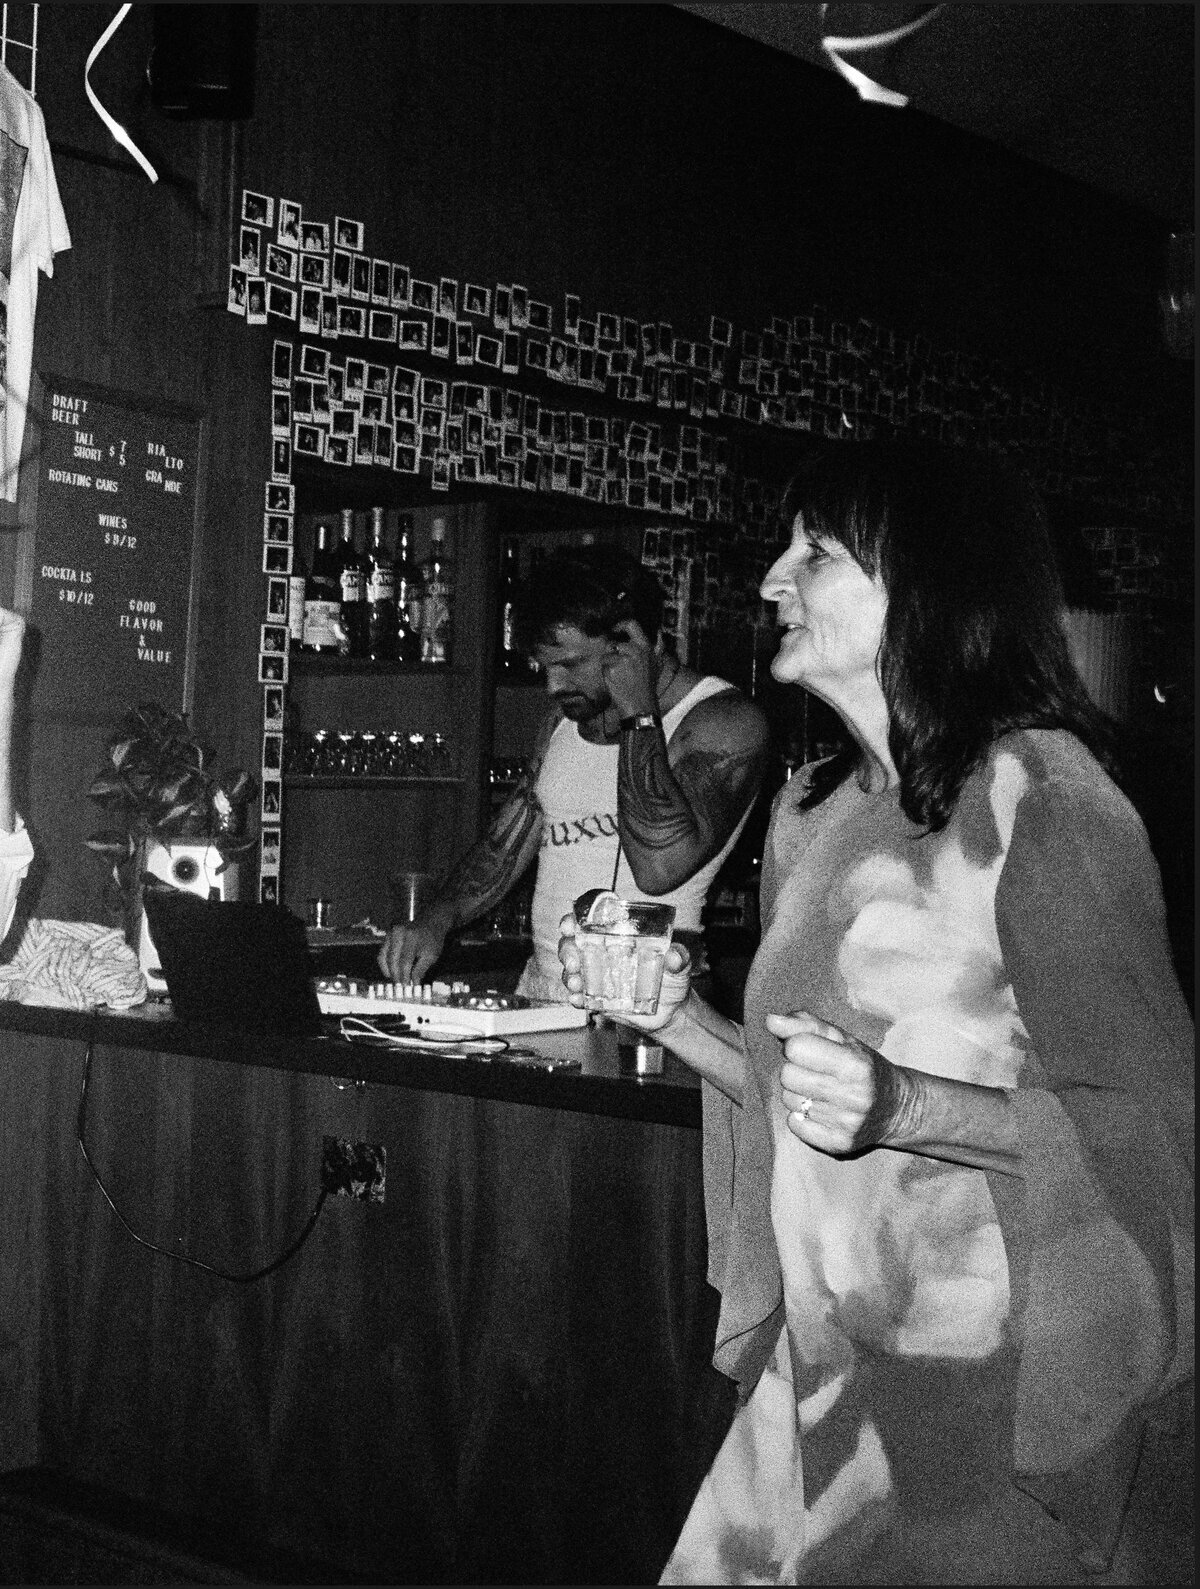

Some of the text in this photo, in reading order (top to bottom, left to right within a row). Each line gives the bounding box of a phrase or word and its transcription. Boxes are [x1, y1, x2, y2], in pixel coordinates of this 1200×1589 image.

[52, 394, 89, 413] DRAFT
[51, 408, 79, 425] BEER
[74, 431, 94, 446] TALL
[73, 446, 102, 461] SHORT
[147, 442, 166, 457] RIA
[165, 456, 183, 470] LTO
[49, 468, 119, 492] ROTATING CANS
[99, 514, 128, 529] WINES
[129, 599, 156, 613] GOOD
[120, 615, 163, 632] FLAVOR
[138, 648, 171, 663] VALUE
